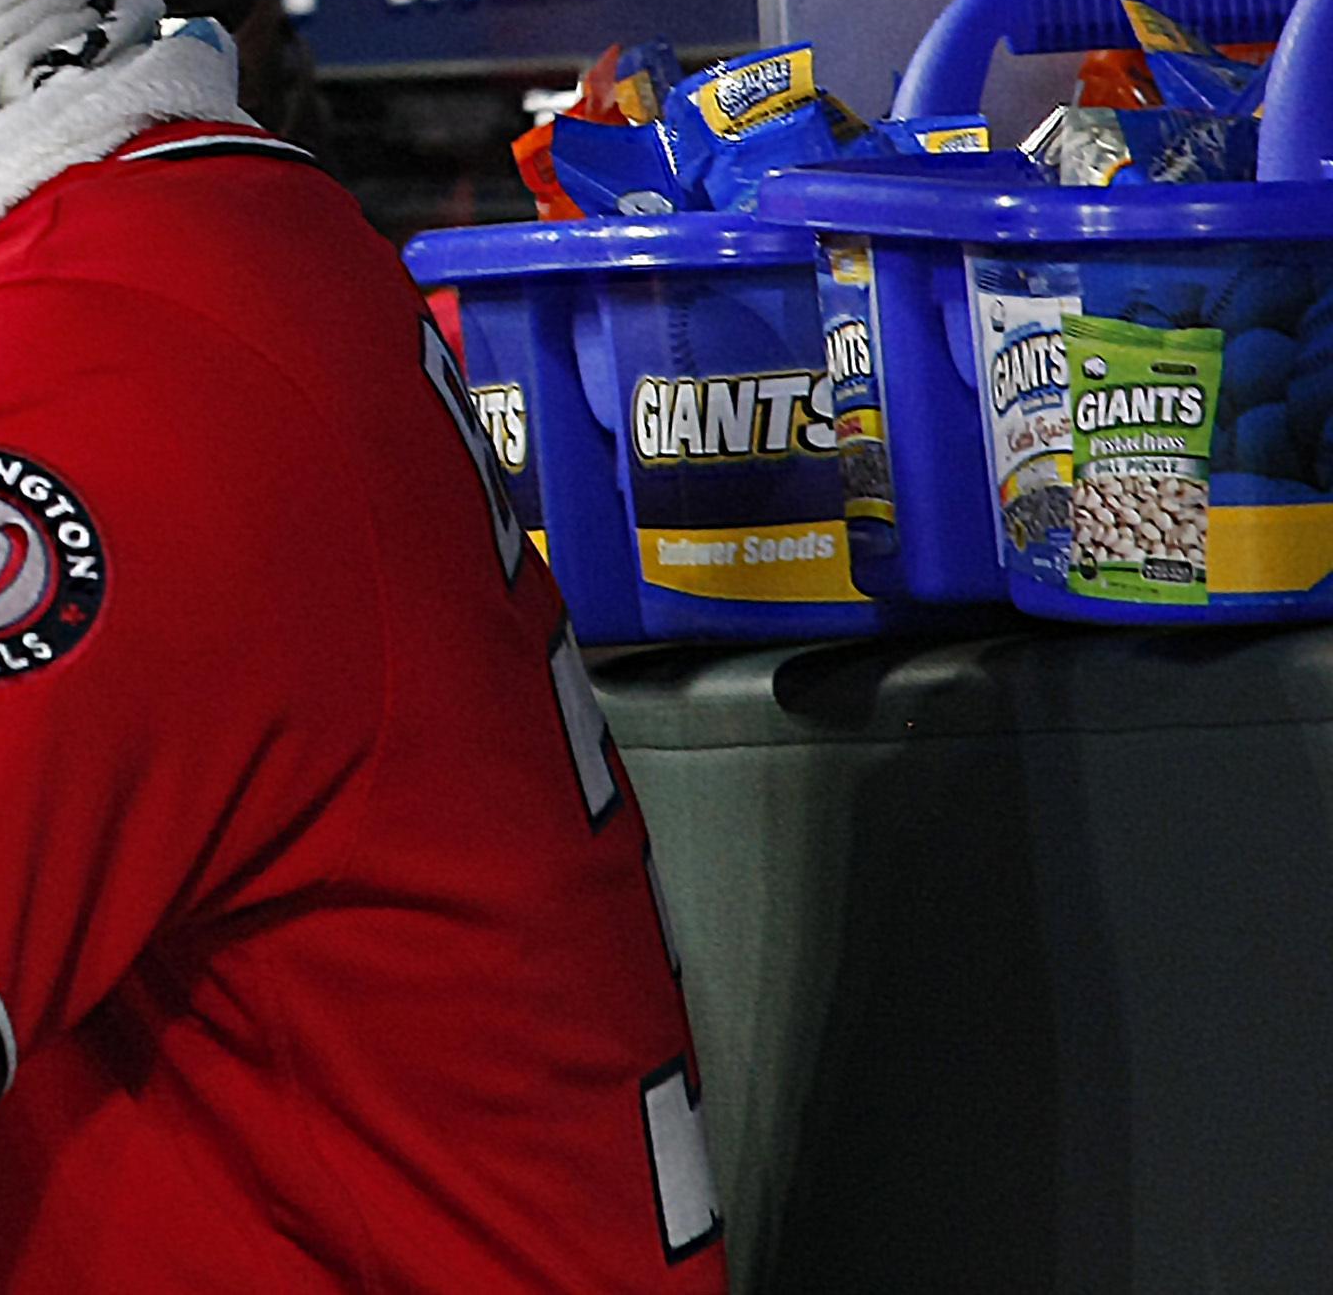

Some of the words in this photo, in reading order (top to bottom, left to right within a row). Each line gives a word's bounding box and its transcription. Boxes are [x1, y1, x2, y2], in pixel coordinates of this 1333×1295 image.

[993, 333, 1069, 412] GIANTS
[635, 373, 838, 461] GIANTS
[1076, 385, 1203, 432] GIANTS
[743, 531, 836, 565] Seeds
